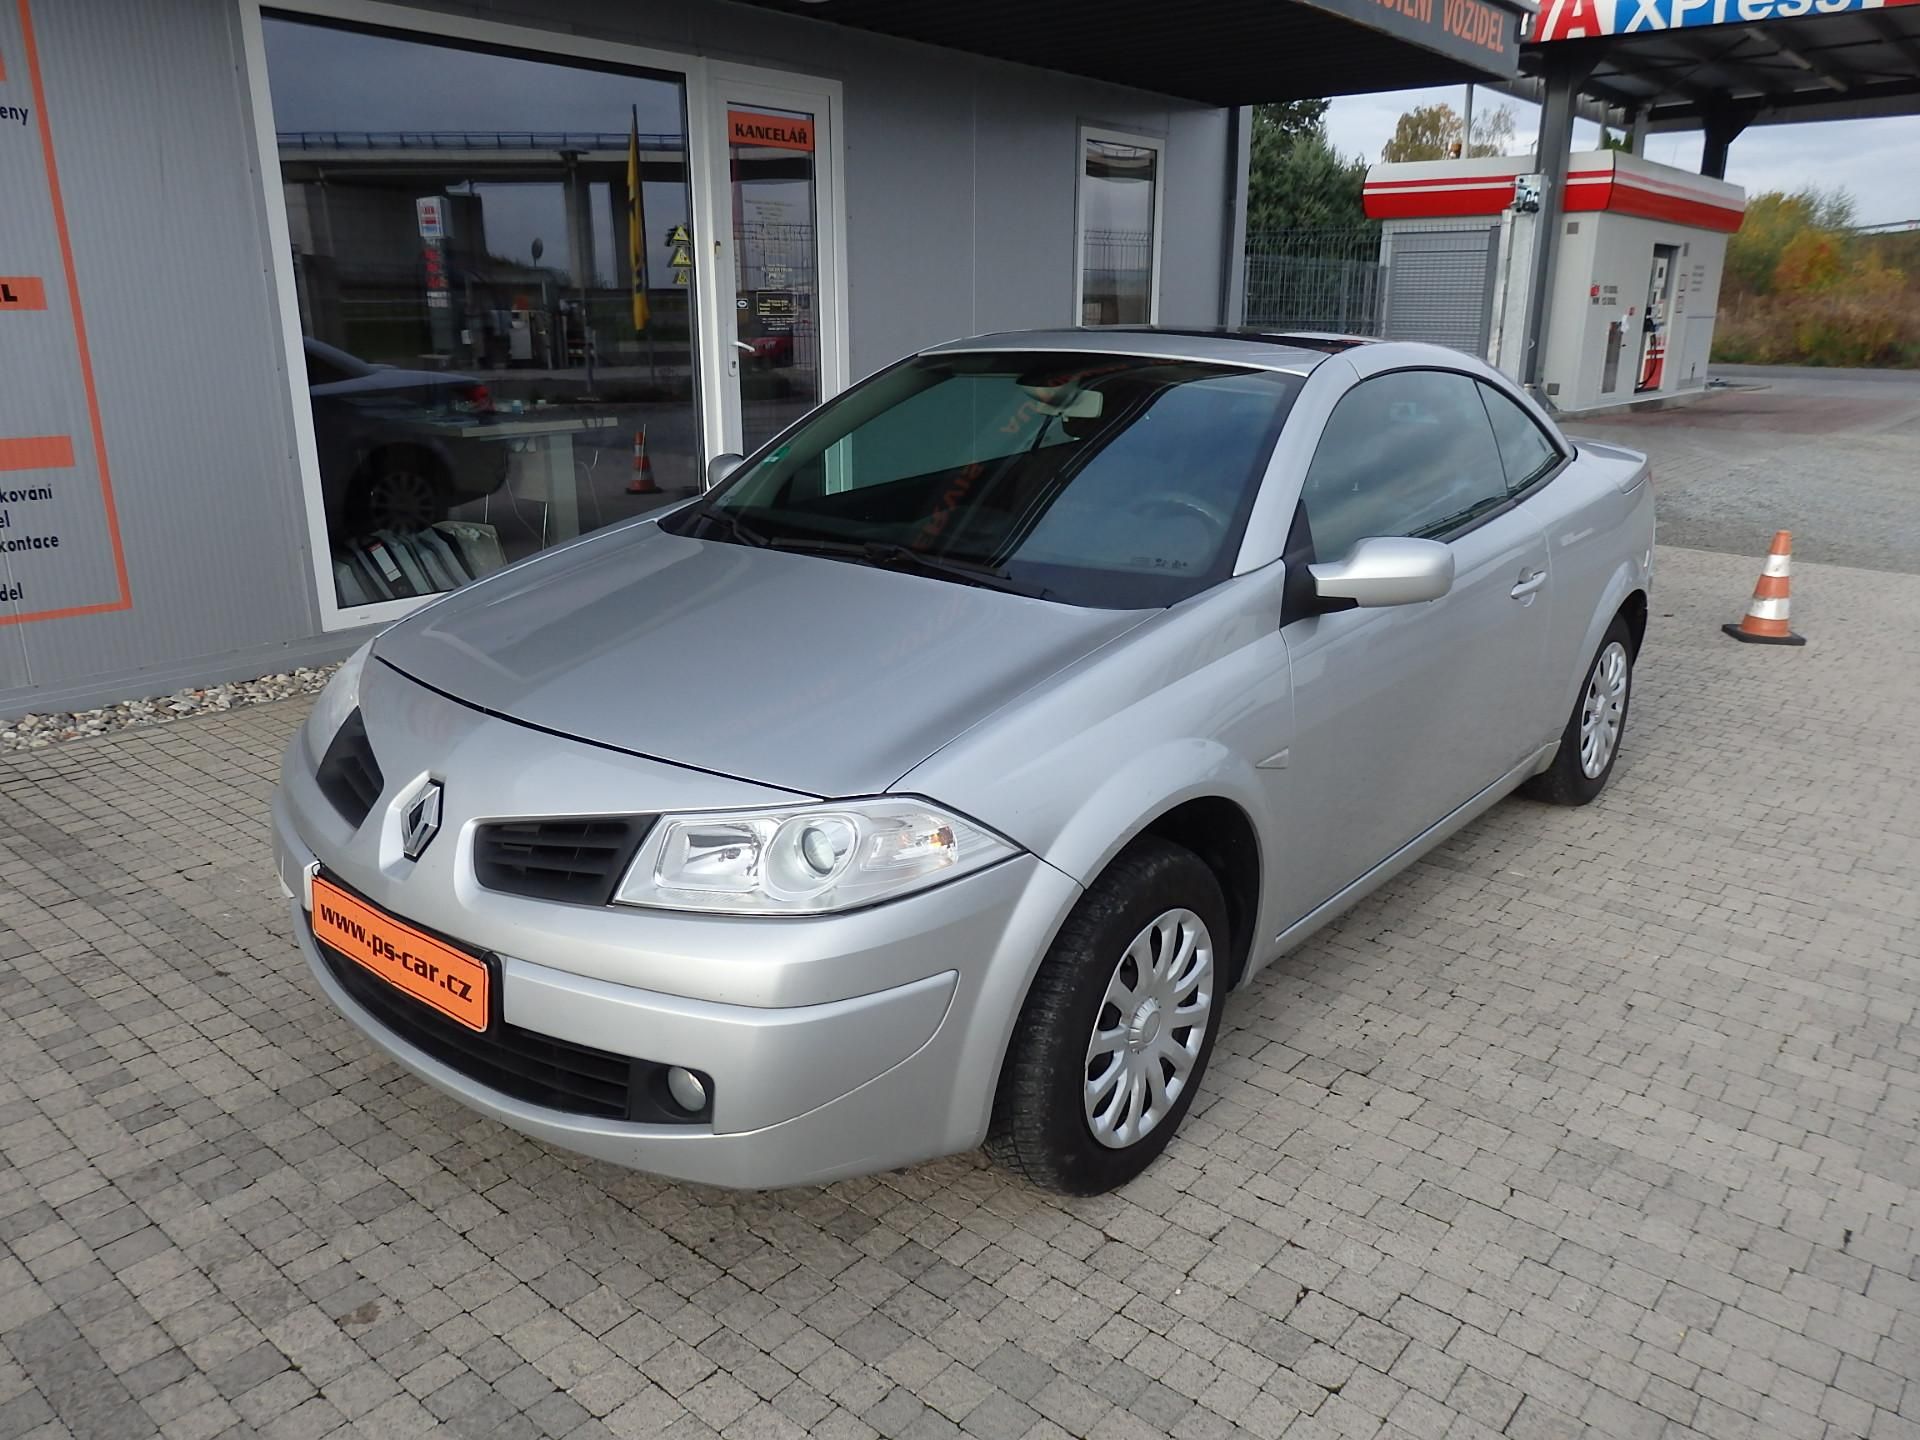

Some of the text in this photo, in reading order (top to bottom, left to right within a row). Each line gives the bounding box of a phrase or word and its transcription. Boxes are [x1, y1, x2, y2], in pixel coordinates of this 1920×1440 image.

[1443, 0, 1504, 52] VOZIDEL
[735, 123, 808, 145] KANCELÁŘ
[320, 903, 473, 1003] www.ps-car.cz
